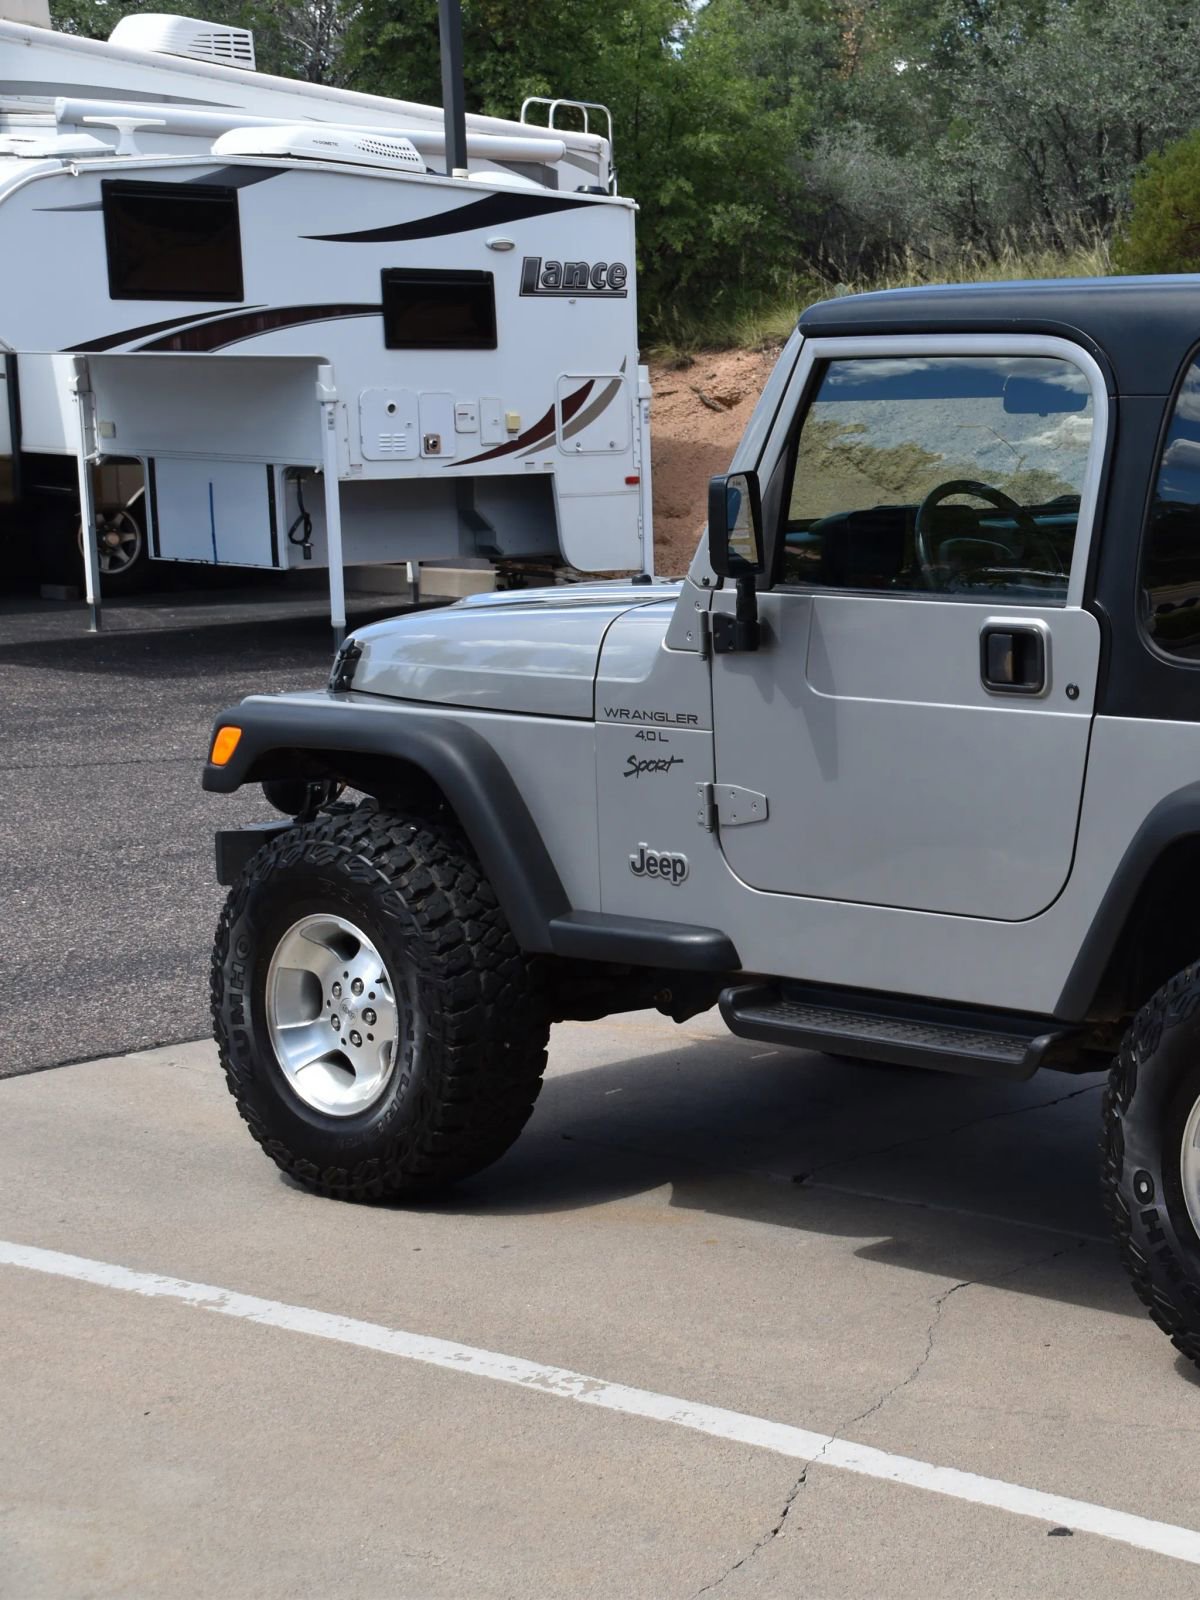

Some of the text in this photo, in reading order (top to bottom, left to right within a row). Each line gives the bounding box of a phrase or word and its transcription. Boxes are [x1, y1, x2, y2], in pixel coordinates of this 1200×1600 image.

[519, 256, 629, 298] Lance
[604, 707, 699, 725] WRANGLER
[623, 754, 684, 779] Sport
[629, 842, 689, 885] Jeep
